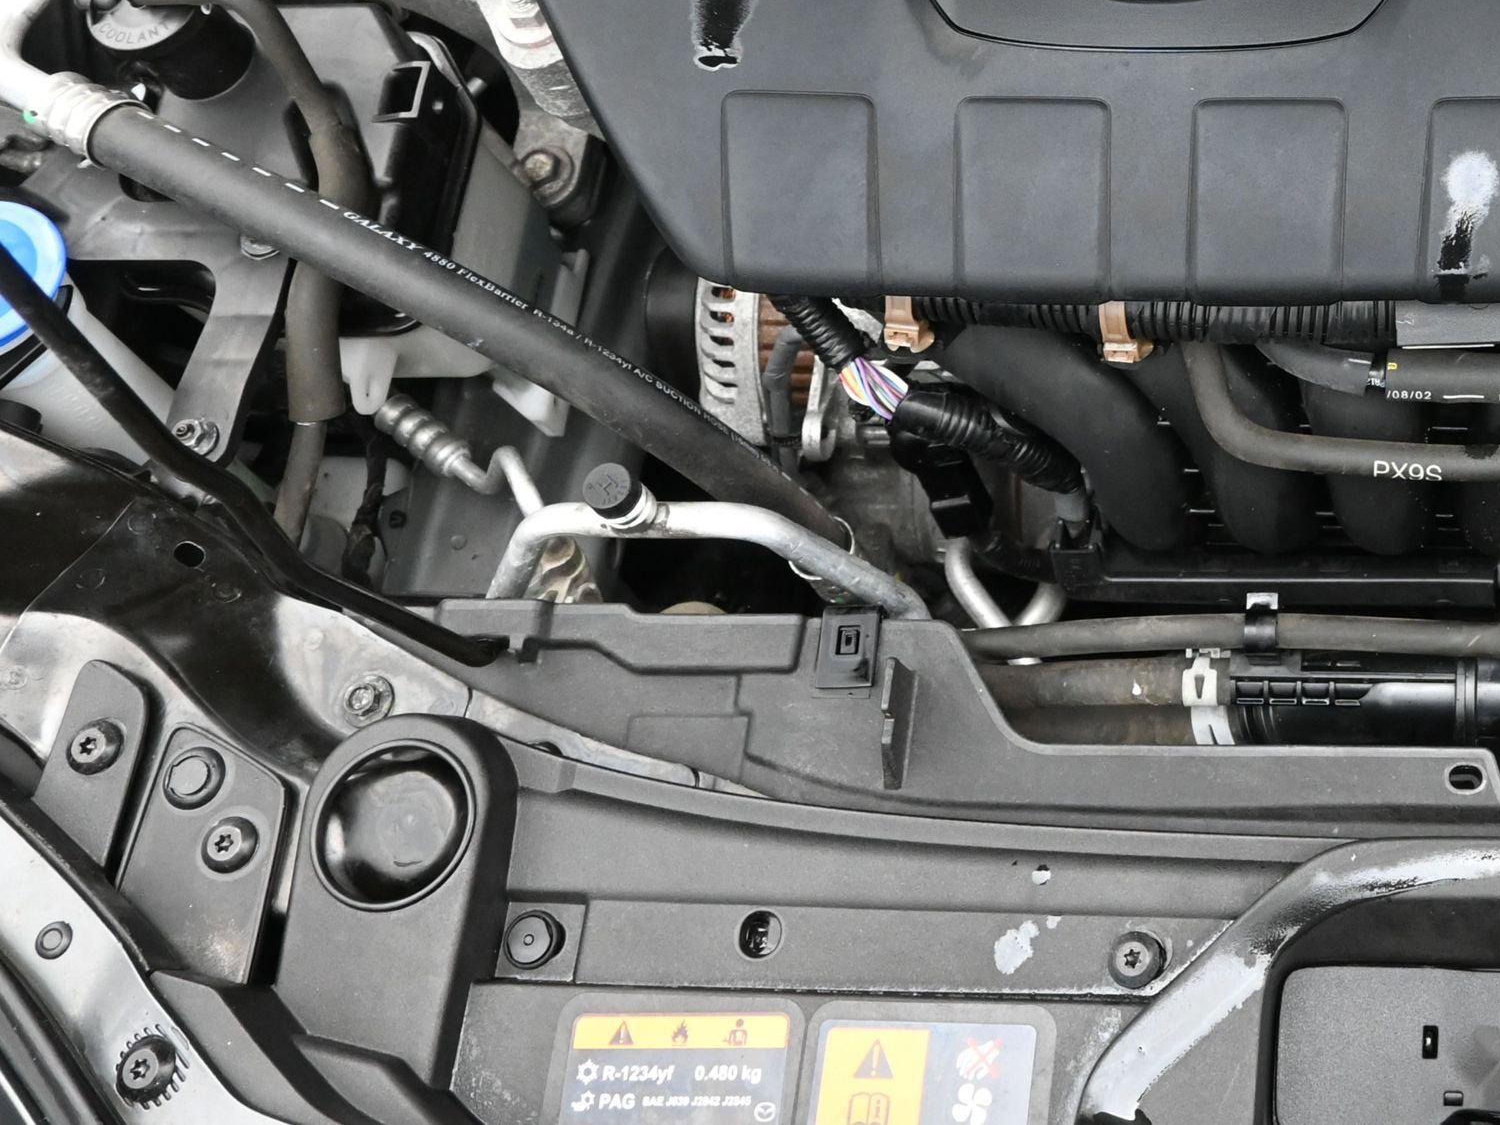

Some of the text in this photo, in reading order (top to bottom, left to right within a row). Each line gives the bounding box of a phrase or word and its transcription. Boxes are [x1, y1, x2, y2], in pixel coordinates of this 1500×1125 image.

[98, 19, 170, 44] COOLANT
[342, 209, 424, 252] GALAXY
[422, 249, 457, 270] 4880
[456, 266, 531, 311] FlexBarrier
[532, 307, 575, 336] R-134a
[632, 366, 655, 385] A/C
[654, 380, 703, 415] SUCTION
[1373, 460, 1443, 481] PX9S
[602, 1064, 762, 1084] R-1234yf 0.480 kg
[598, 1093, 636, 1110] PAG
[642, 1095, 664, 1107] SAE
